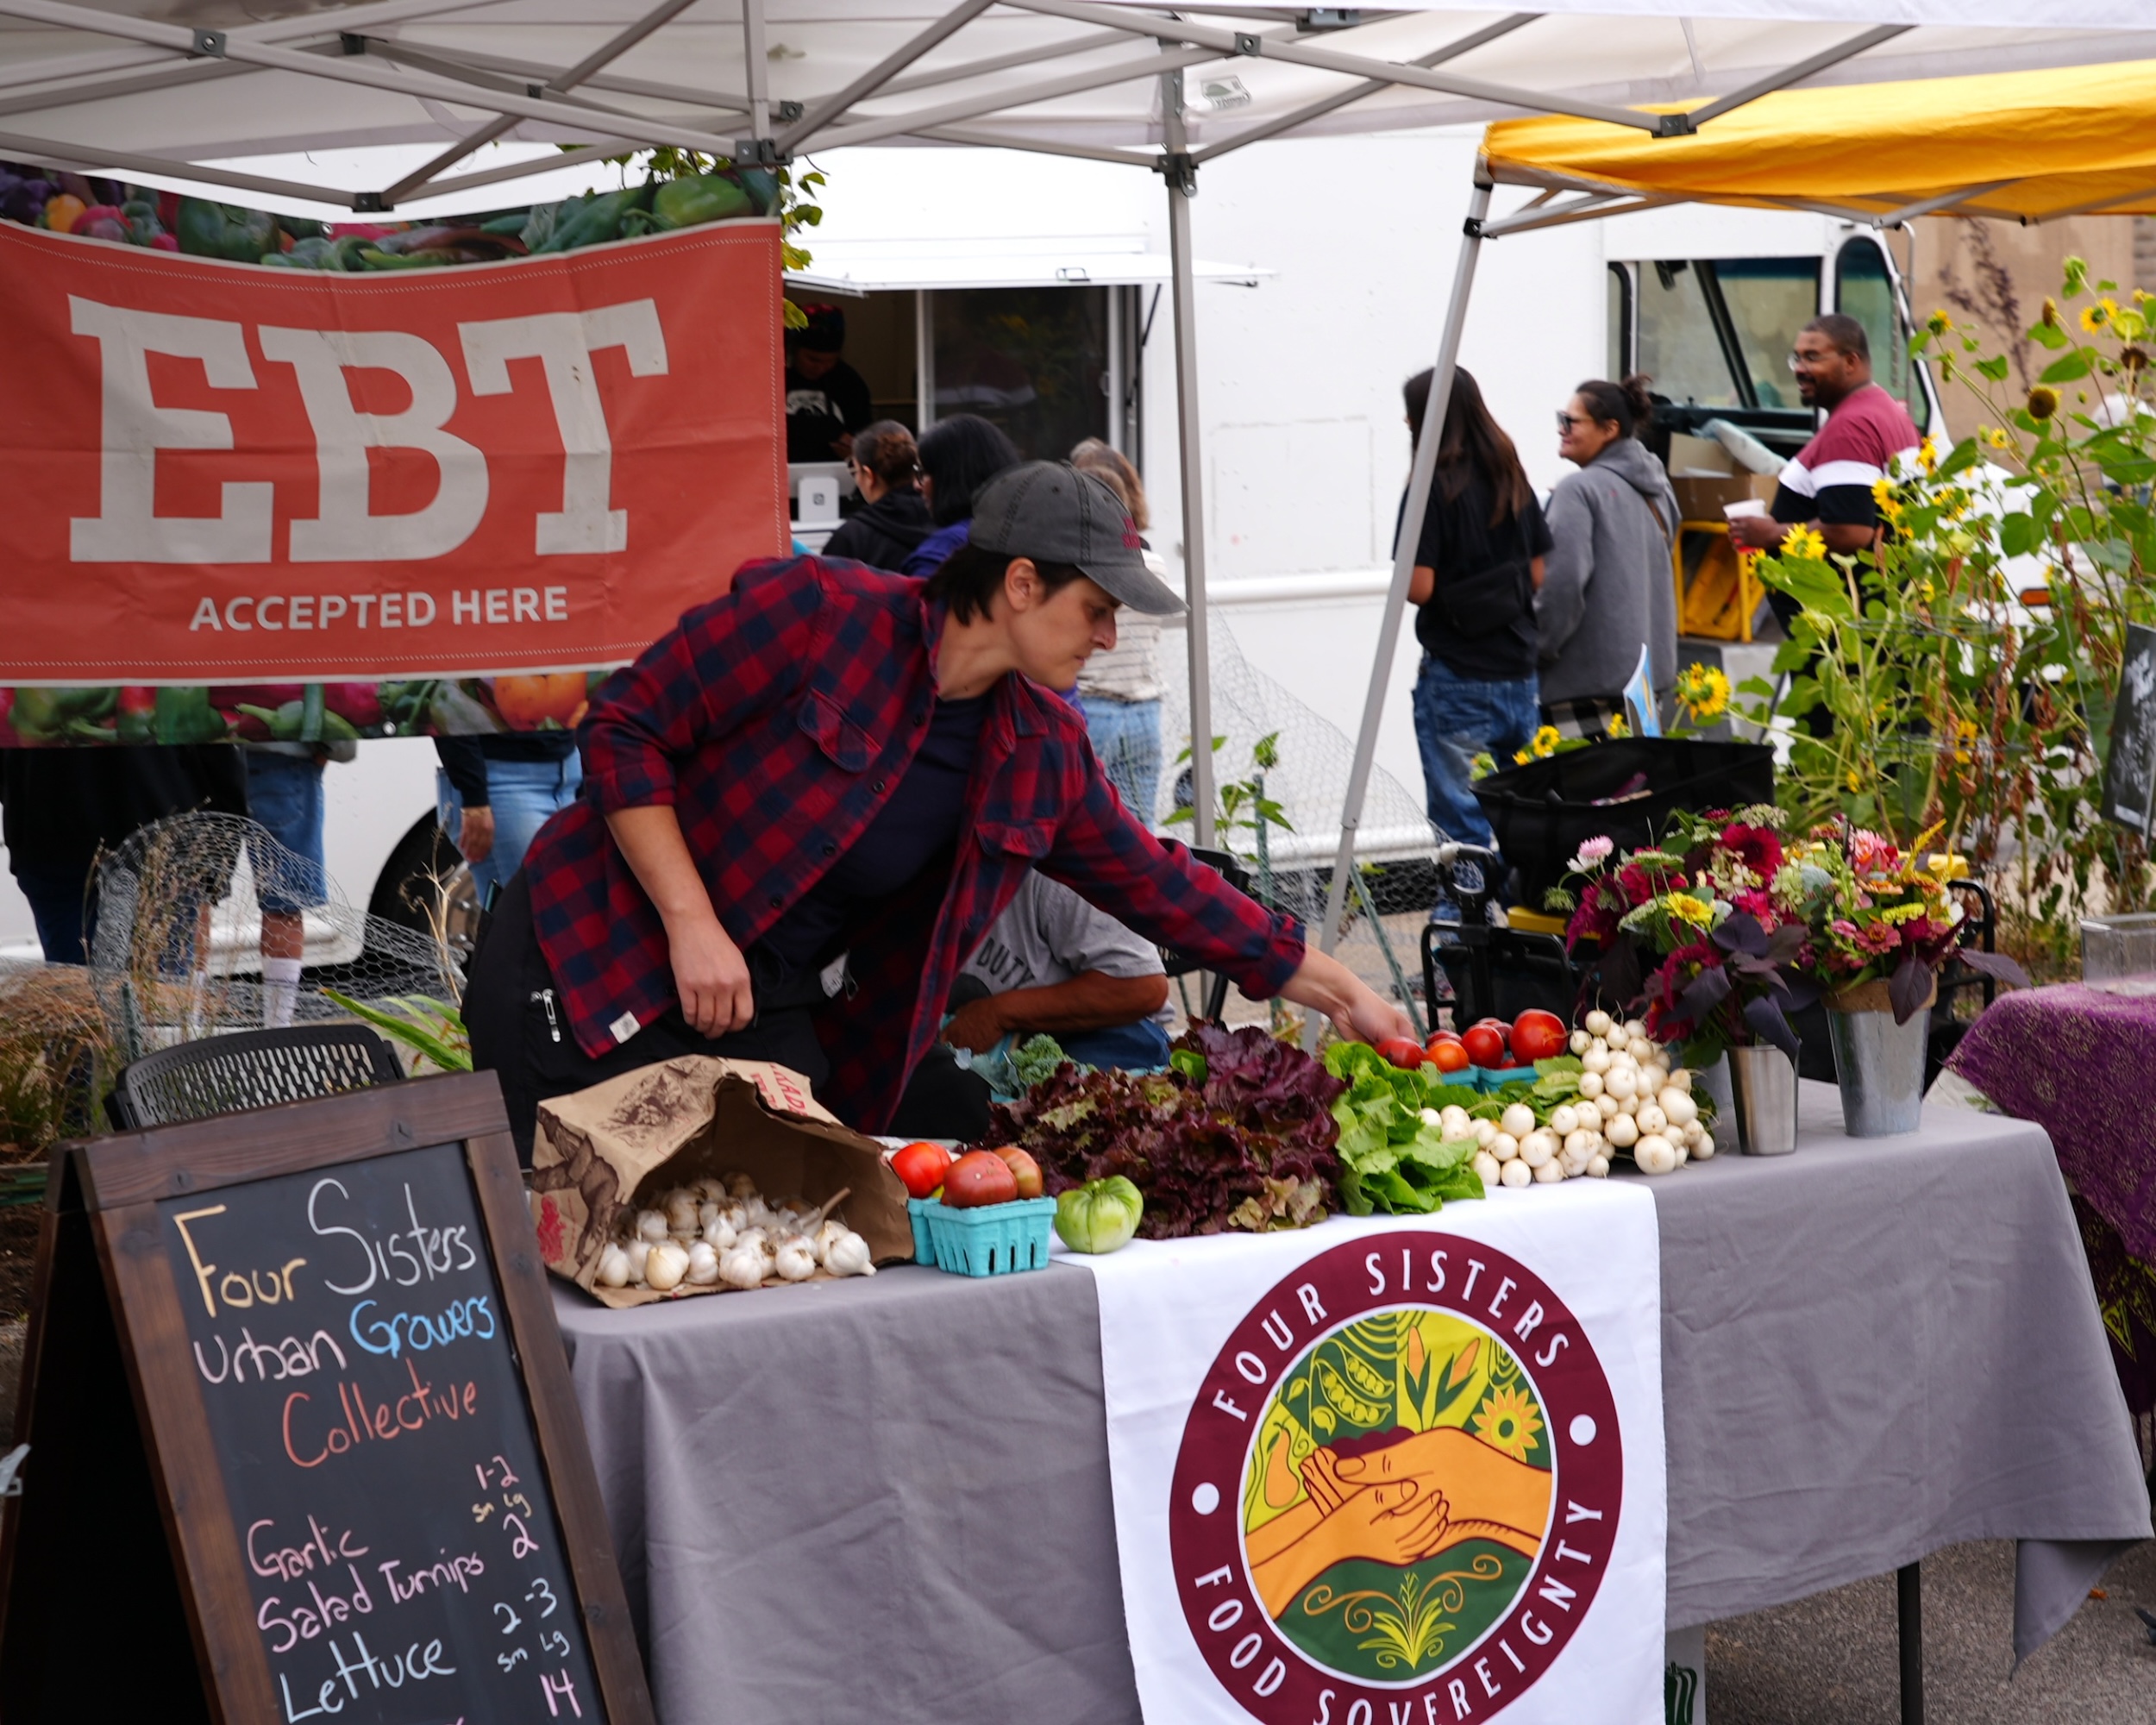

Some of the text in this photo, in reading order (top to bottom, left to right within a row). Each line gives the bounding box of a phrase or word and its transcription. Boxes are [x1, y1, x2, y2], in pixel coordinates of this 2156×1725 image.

[67, 293, 669, 564] EBT
[189, 585, 568, 631] ACCEPTED HERE
[975, 937, 1036, 990] DUTY
[172, 1203, 308, 1319] Four
[307, 1177, 477, 1295] Sisters
[192, 1295, 495, 1383] Urban Growers
[1212, 1247, 1570, 1422] FOUR SISTERS
[282, 1357, 478, 1468] Collective
[247, 1455, 520, 1583] Garlic 1-2
[257, 1513, 540, 1653] Salad Turnips 2
[1194, 1498, 1603, 1725] FOOD SOVEREIGNTY
[279, 1631, 457, 1724] Lettuce
[538, 1667, 582, 1718] 14
[539, 1630, 570, 1658] Lg
